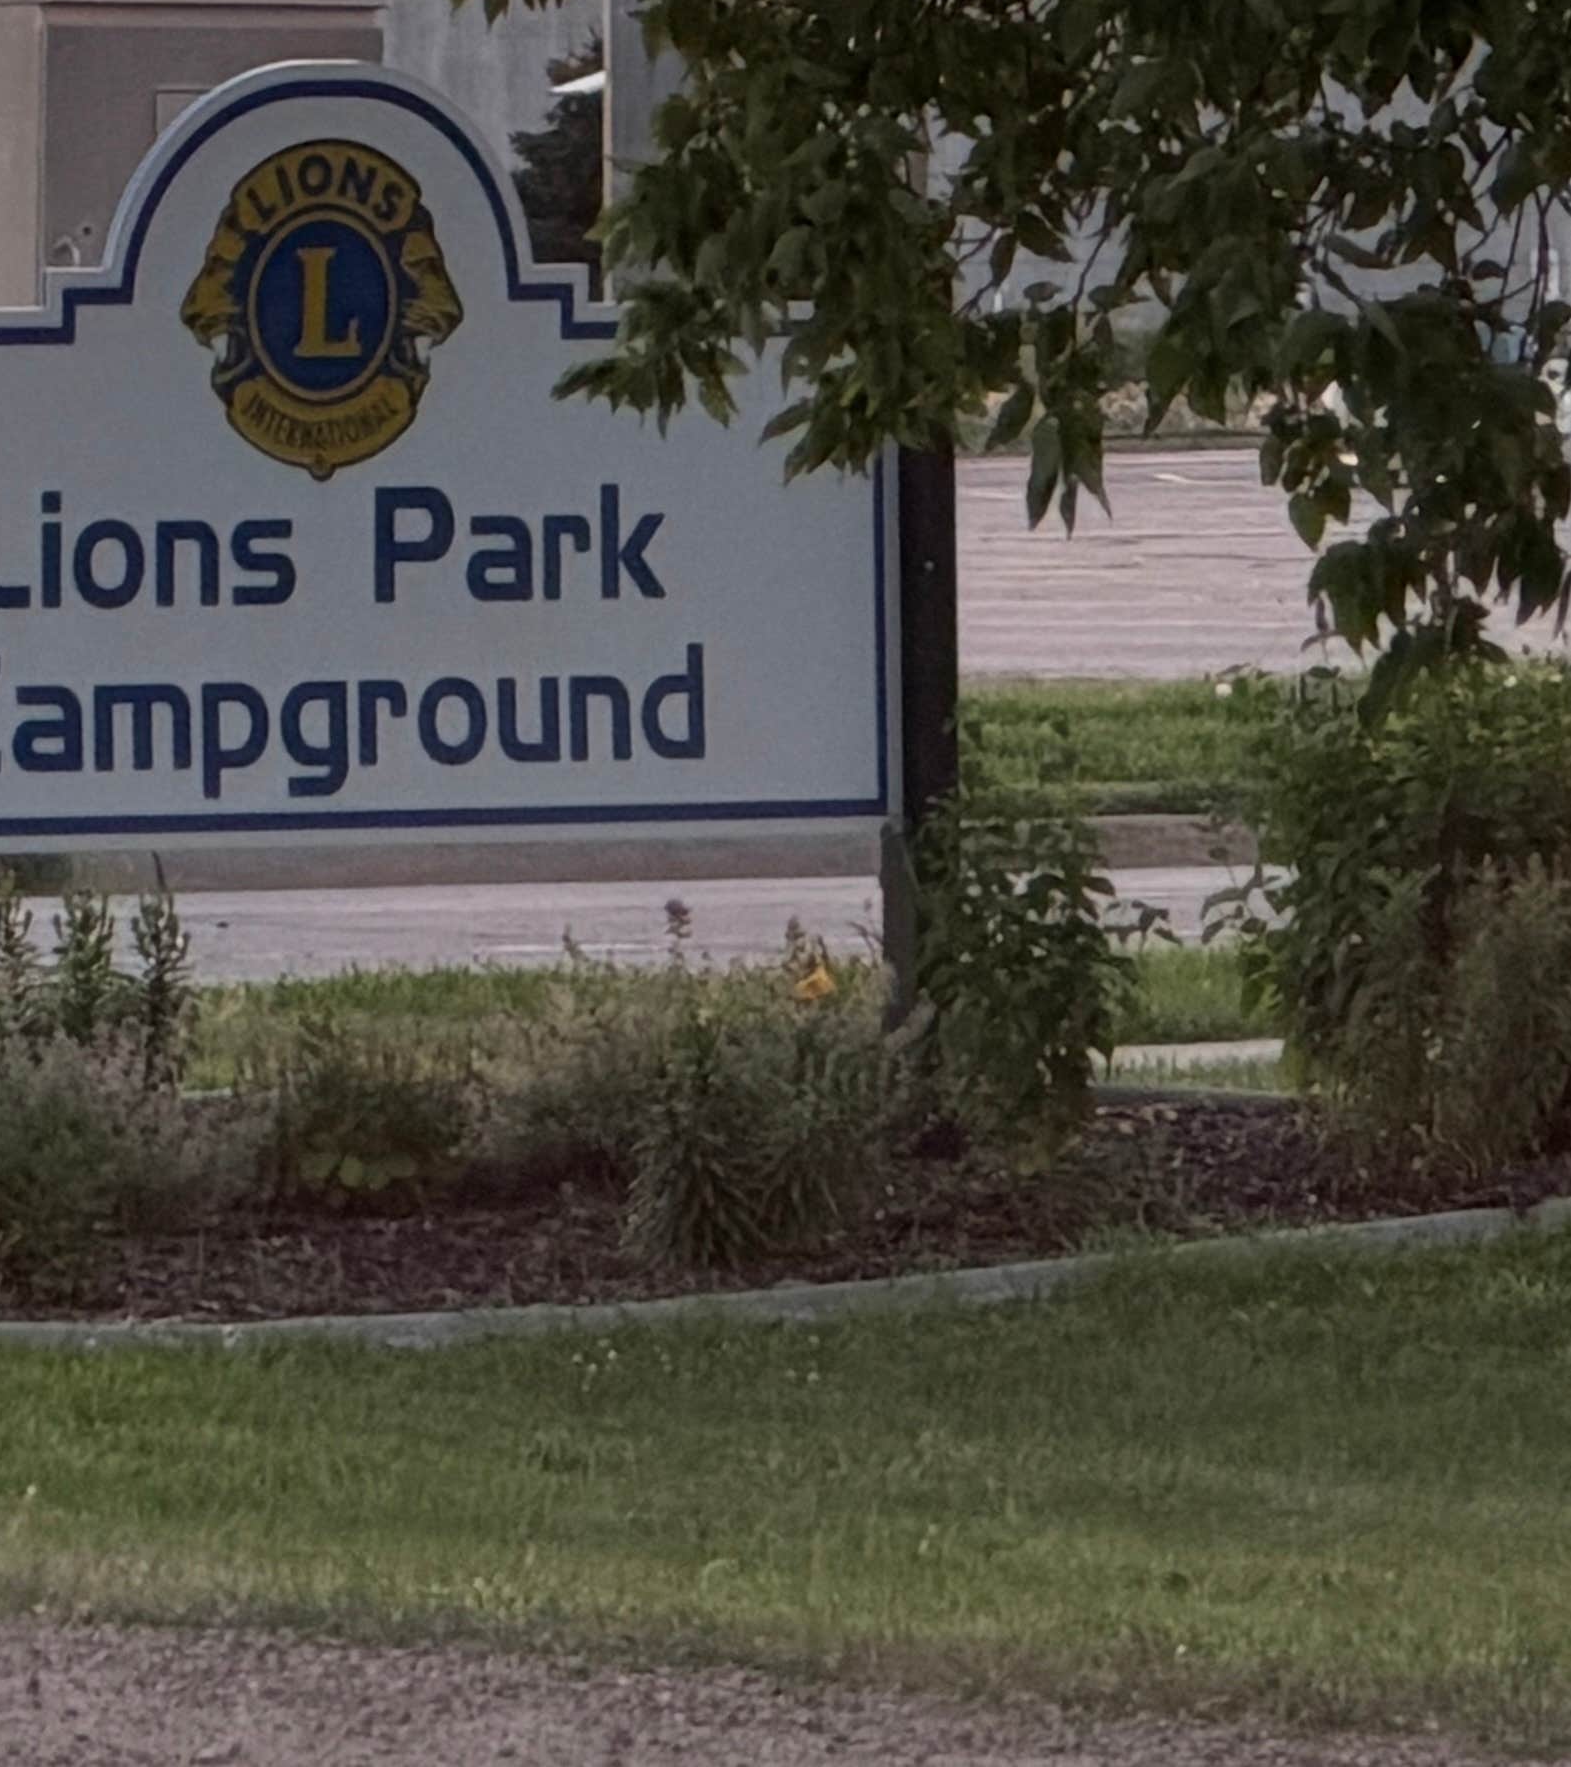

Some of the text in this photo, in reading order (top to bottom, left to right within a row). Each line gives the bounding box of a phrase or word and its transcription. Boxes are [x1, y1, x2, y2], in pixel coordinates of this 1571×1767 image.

[244, 153, 405, 223] LIONS
[292, 245, 363, 358] L
[372, 482, 667, 604] Park
